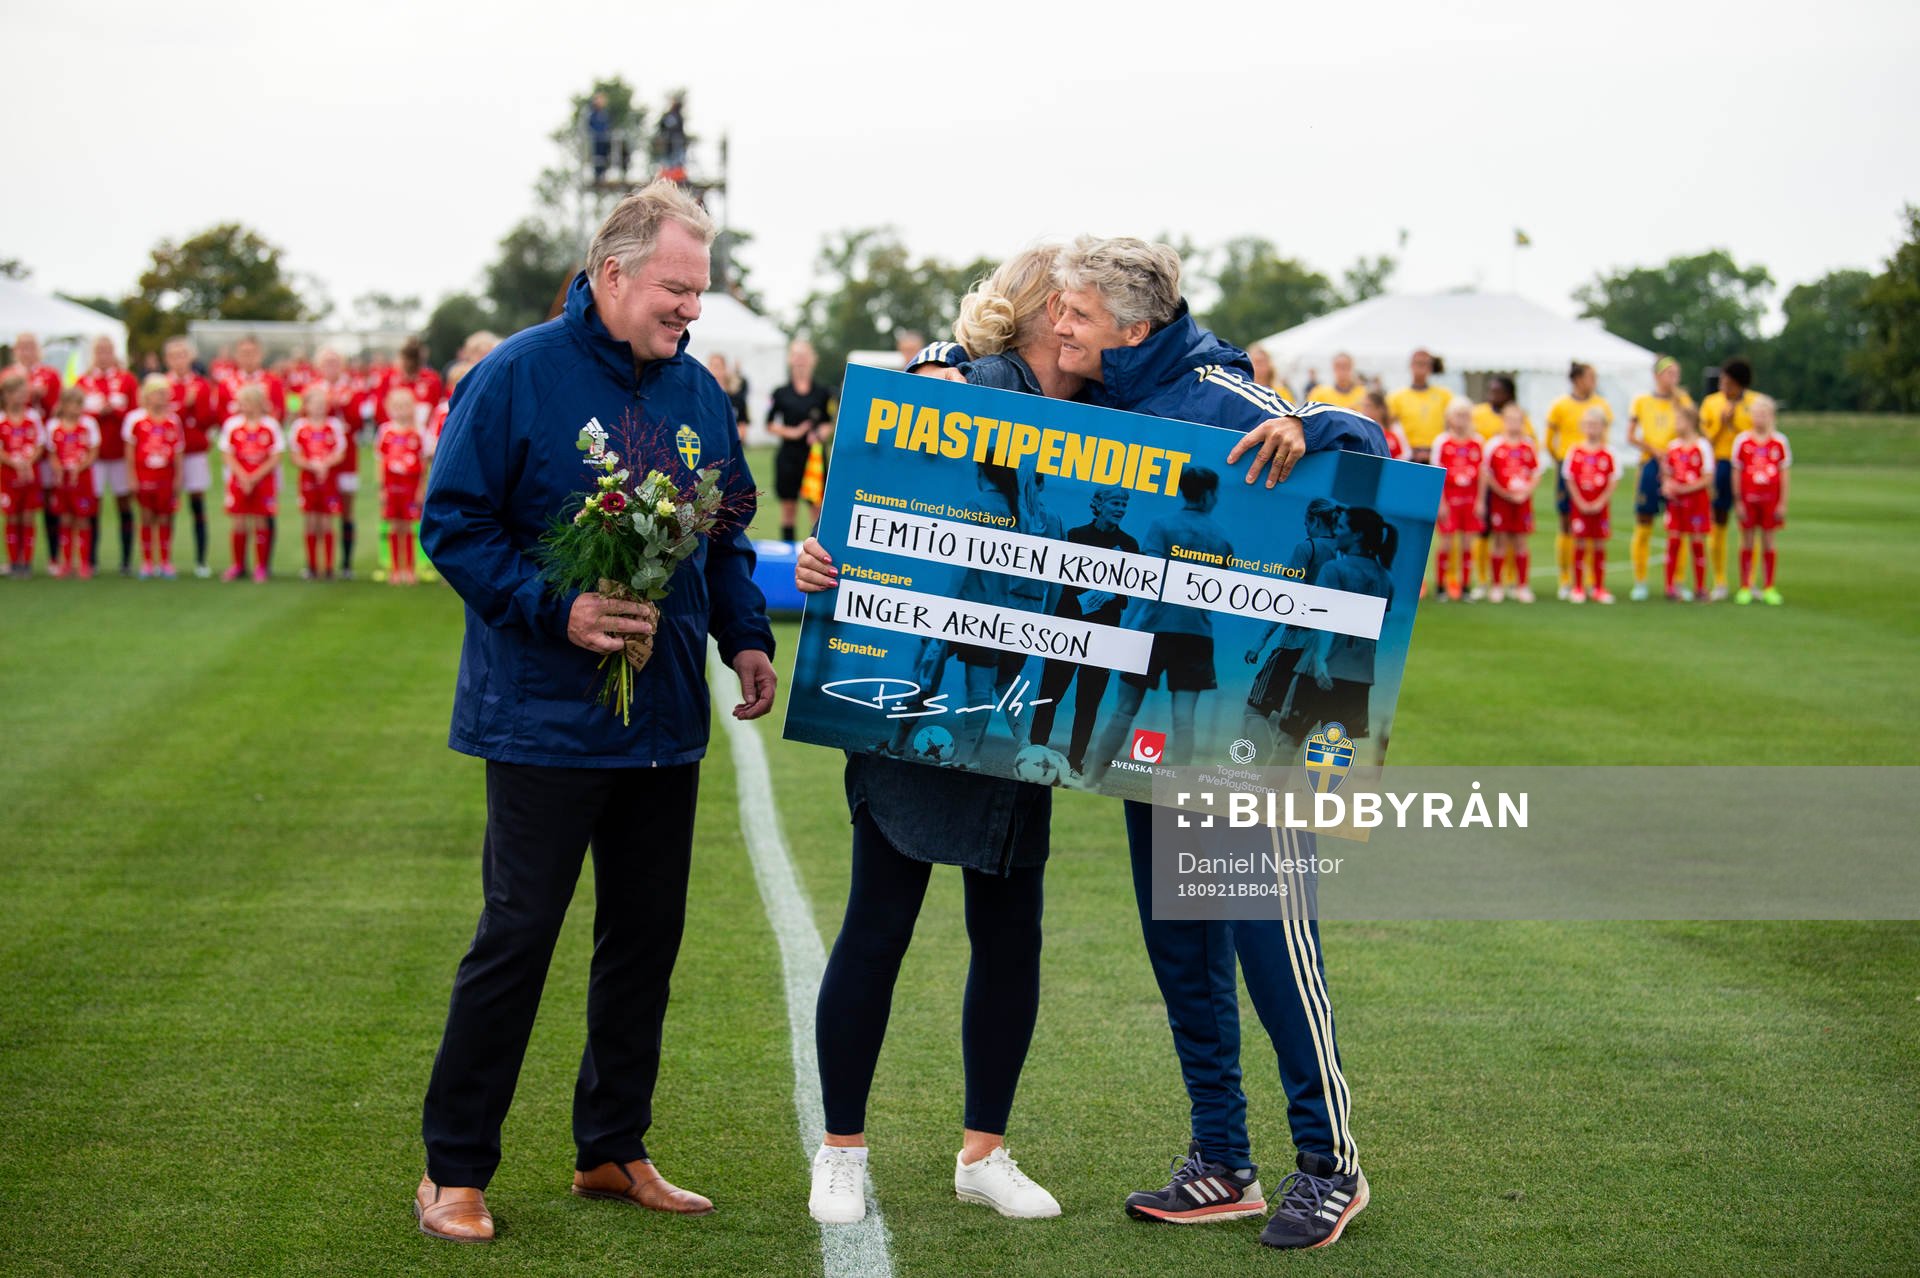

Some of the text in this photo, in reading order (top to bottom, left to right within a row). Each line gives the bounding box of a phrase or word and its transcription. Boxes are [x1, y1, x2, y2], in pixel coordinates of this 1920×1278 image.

[865, 397, 1192, 497] PIASTIPENDIET
[854, 488, 1017, 529] Summa (med bokstäver)
[840, 563, 913, 588] Pristagare
[965, 535, 1048, 576] TUSEN
[1058, 553, 1160, 596] KRONOR
[1170, 544, 1307, 581] Summa (med siffror)
[847, 590, 1091, 659] INGER ARNESSON
[828, 637, 888, 659] Signatur
[1111, 759, 1178, 779] SVENSKA SPEL
[1216, 764, 1262, 781] Together
